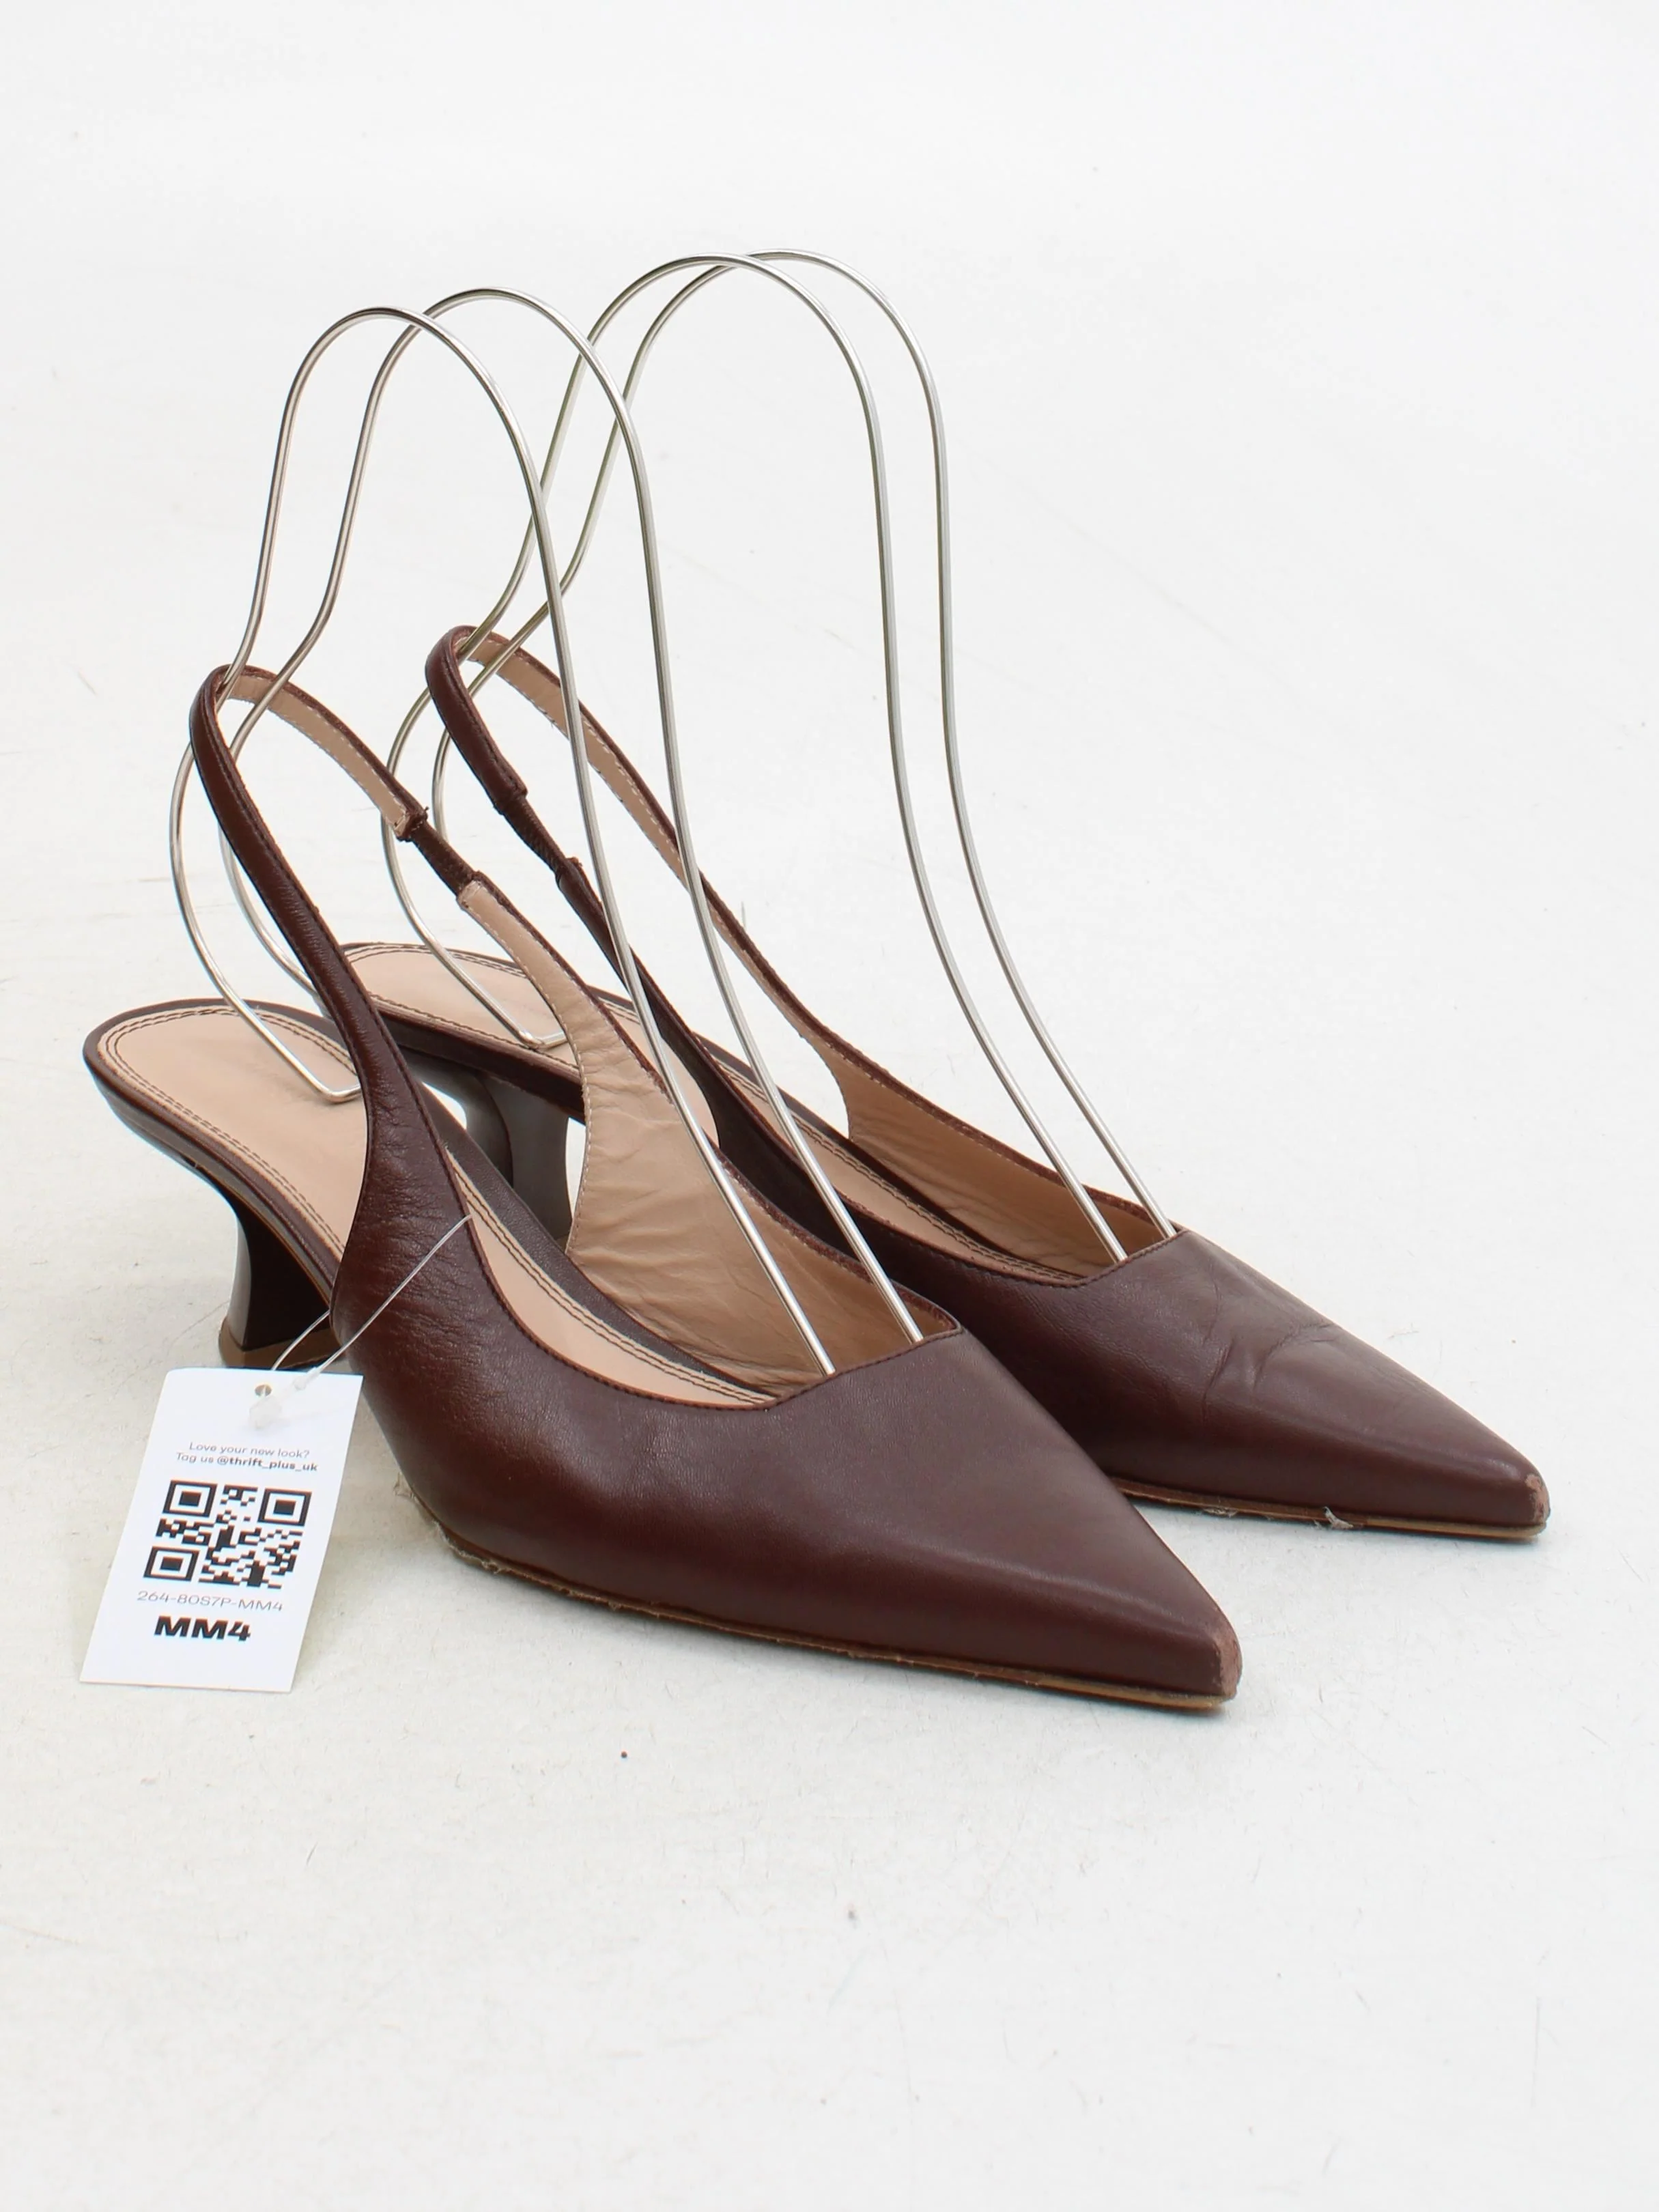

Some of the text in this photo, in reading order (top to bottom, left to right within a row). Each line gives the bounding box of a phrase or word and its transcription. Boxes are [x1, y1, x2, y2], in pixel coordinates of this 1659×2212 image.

[189, 1442, 310, 1459] Love your new look?
[176, 1452, 318, 1472] Tag us @thrift_plus_uk
[154, 1615, 251, 1642] MM4
